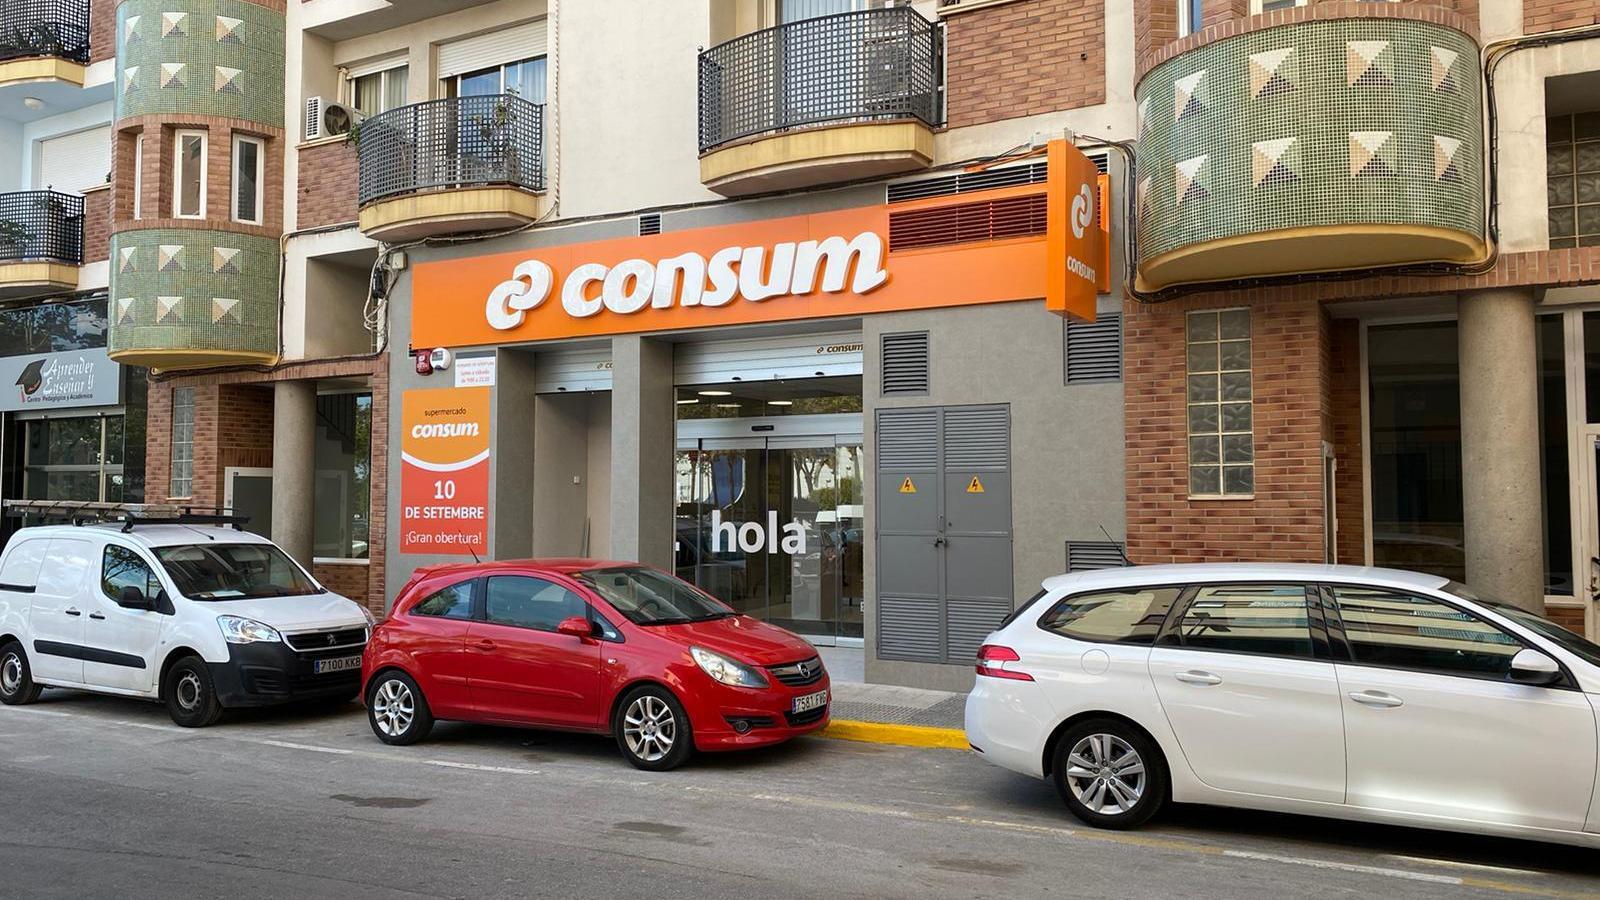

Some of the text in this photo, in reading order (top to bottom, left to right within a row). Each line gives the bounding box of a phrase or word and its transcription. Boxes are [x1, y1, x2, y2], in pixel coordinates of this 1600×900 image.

[562, 231, 888, 318] consum
[1066, 255, 1096, 284] consum
[43, 356, 94, 380] Aprender
[424, 407, 467, 417] supermercado
[411, 422, 479, 438] consum
[434, 480, 456, 500] 10
[405, 506, 485, 519] DE SETEMBRE
[405, 531, 482, 545] ¡Gran obertura!
[711, 509, 807, 554] hola
[321, 660, 343, 671] 7100
[797, 696, 813, 709] 7581
